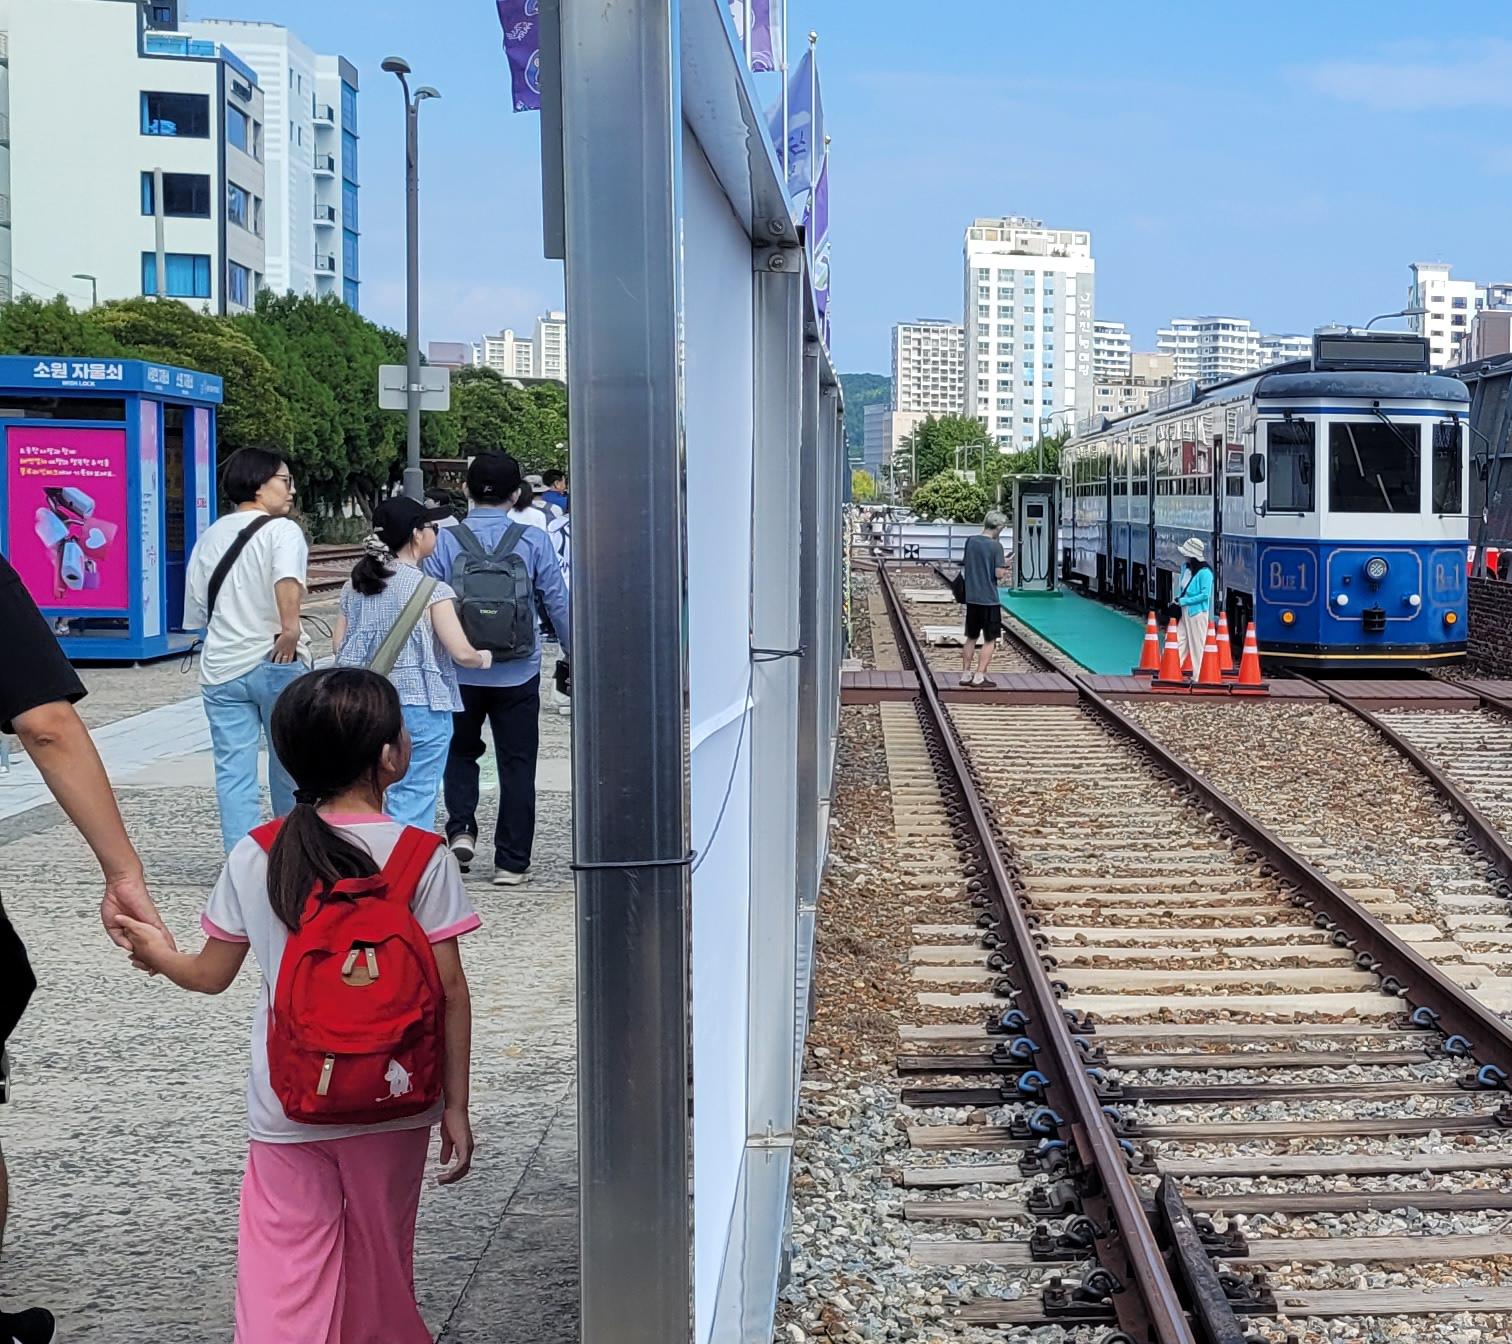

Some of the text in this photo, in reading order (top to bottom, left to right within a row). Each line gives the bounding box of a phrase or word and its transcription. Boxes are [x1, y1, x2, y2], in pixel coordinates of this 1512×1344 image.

[33, 362, 123, 381] 소원 자물쇠
[1298, 563, 1307, 591] 1
